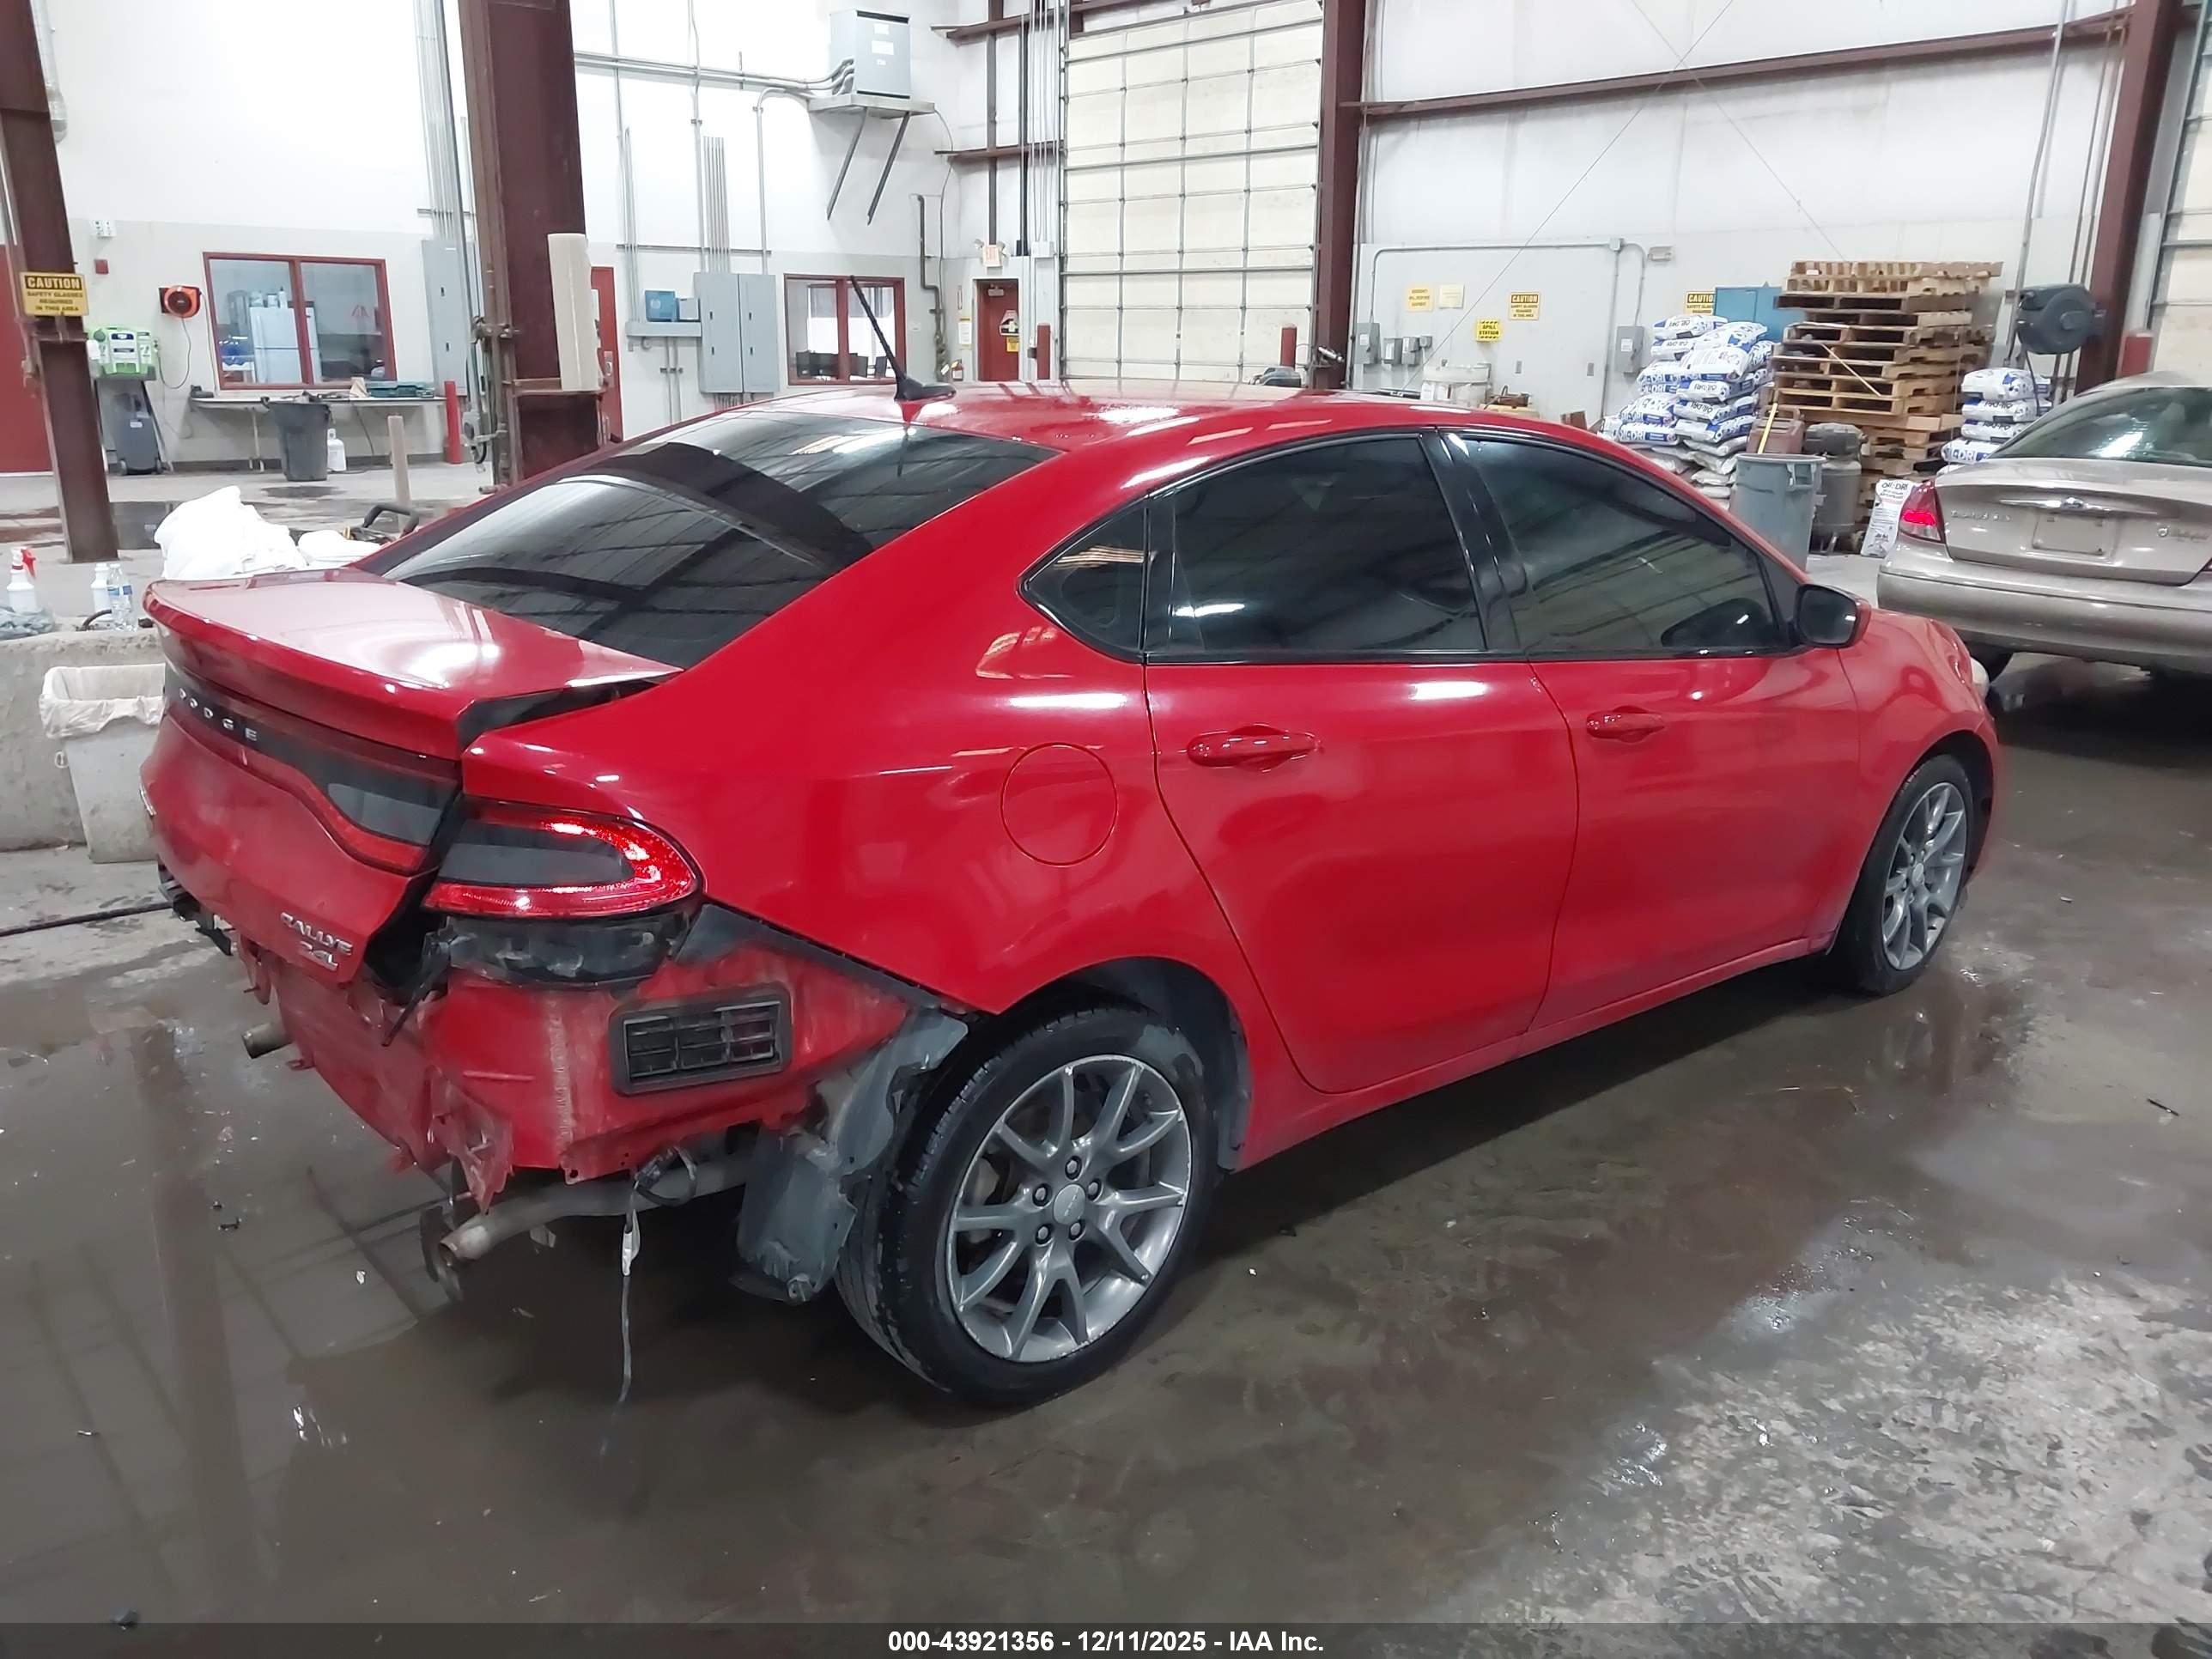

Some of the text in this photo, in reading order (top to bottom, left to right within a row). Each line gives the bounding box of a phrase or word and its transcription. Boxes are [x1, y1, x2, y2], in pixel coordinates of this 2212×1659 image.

[27, 277, 80, 289] CAUTION
[179, 687, 258, 741] DODGE
[280, 912, 353, 956] RALLYE
